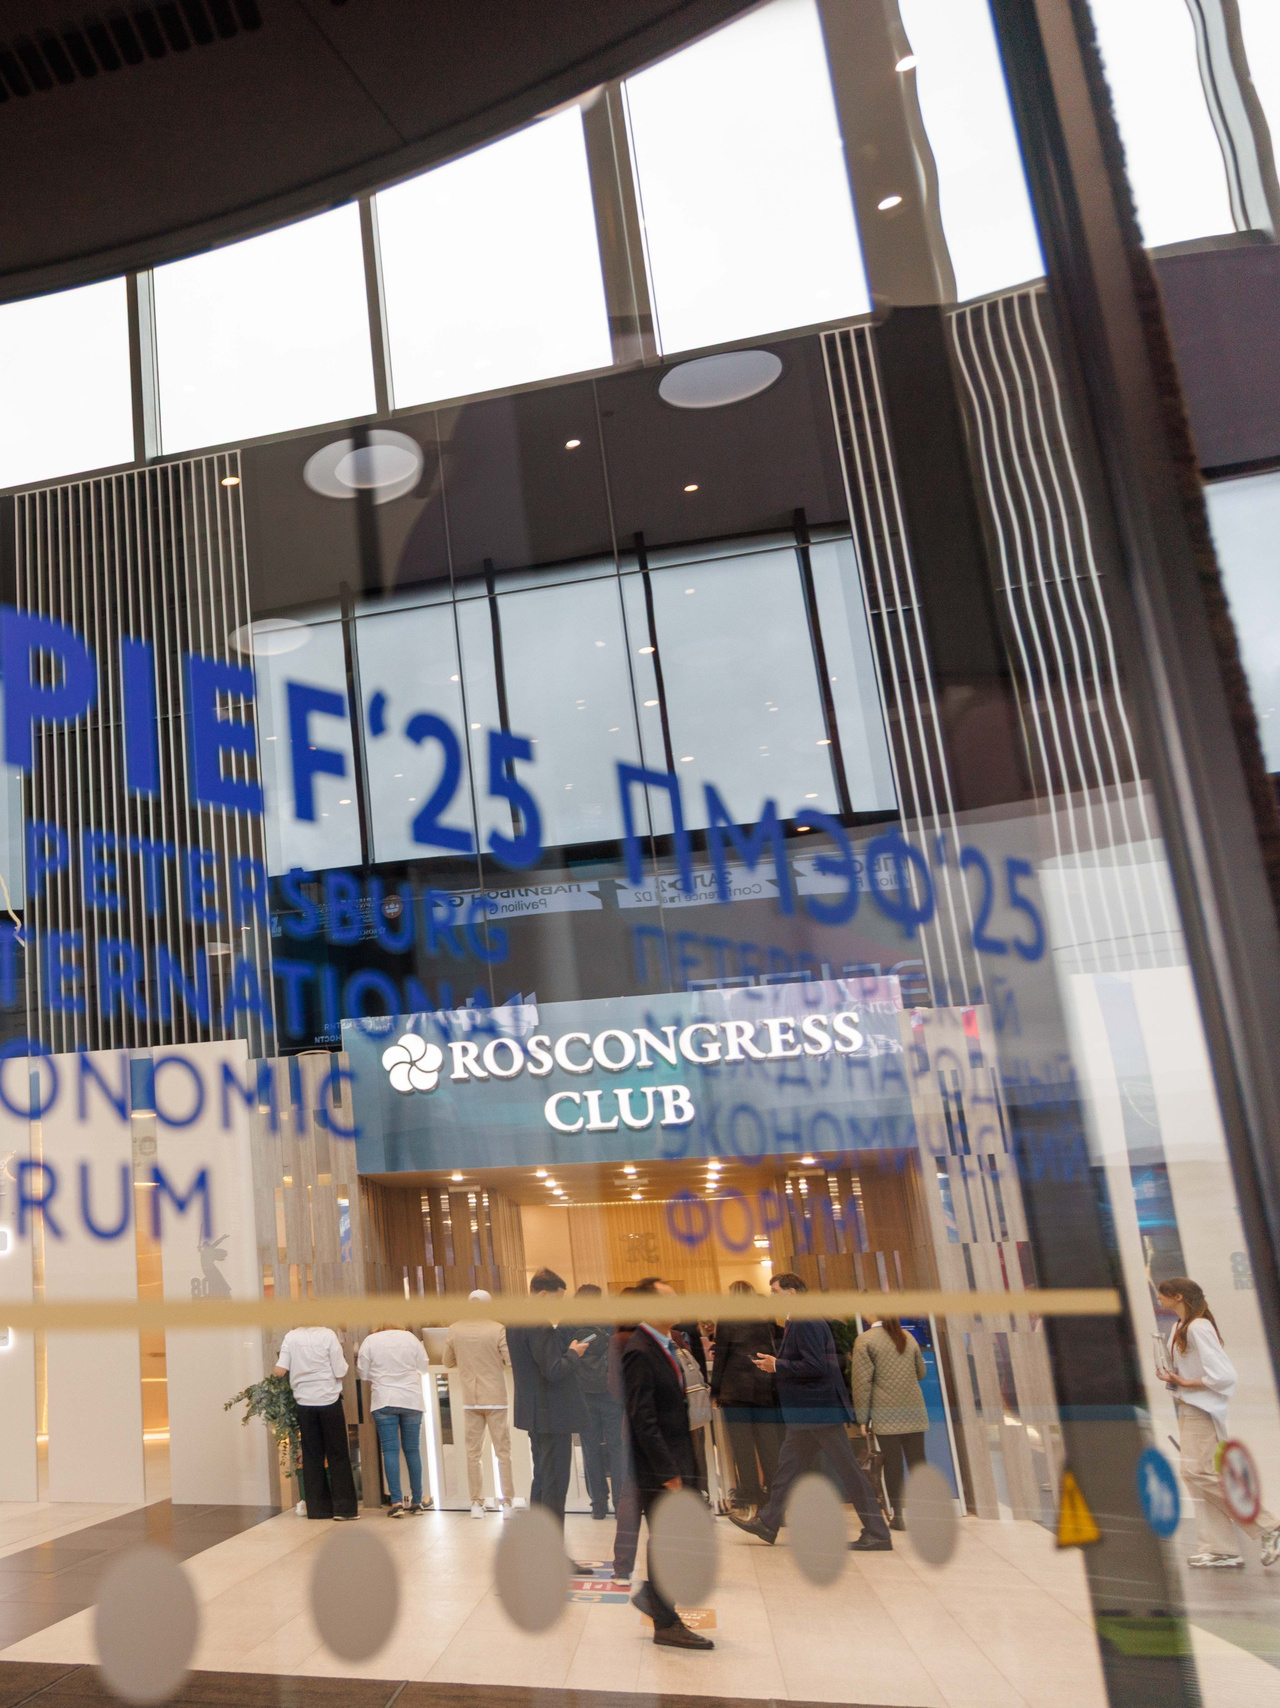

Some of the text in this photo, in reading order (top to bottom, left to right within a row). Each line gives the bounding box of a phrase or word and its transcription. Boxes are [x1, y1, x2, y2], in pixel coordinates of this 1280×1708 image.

[25, 818, 511, 965] PETERSBURG
[448, 1011, 866, 1082] ROSCONGRESS
[543, 1084, 697, 1134] CLUB
